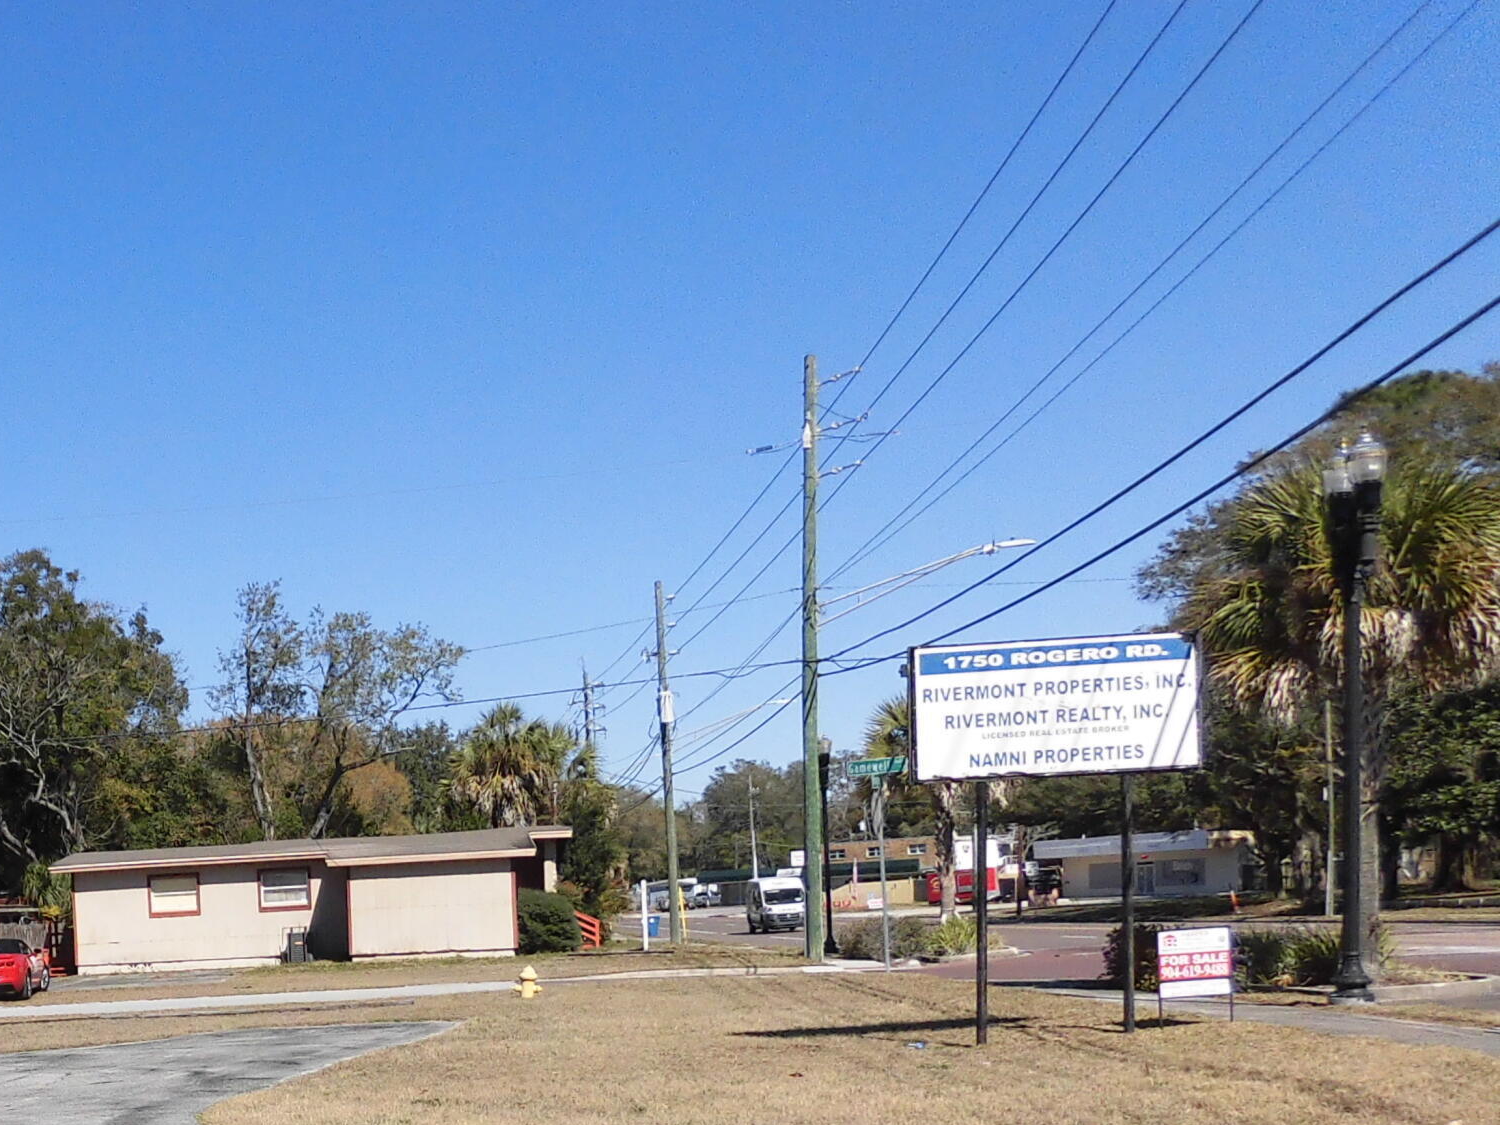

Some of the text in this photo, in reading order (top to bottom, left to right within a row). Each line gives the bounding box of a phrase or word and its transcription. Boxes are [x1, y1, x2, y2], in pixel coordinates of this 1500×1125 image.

[943, 643, 1170, 669] 1750 ROGERO RD.
[922, 682, 1027, 703] RIVERMONT
[1155, 672, 1192, 689] INC.
[944, 709, 1049, 730] RIVERMONT
[1056, 705, 1127, 724] REALTY,
[981, 724, 1130, 740] LICENSED REAL ESTATE BROKER
[969, 744, 1145, 768] NAMNI PROPERTIES
[1160, 952, 1229, 967] FOR SALE
